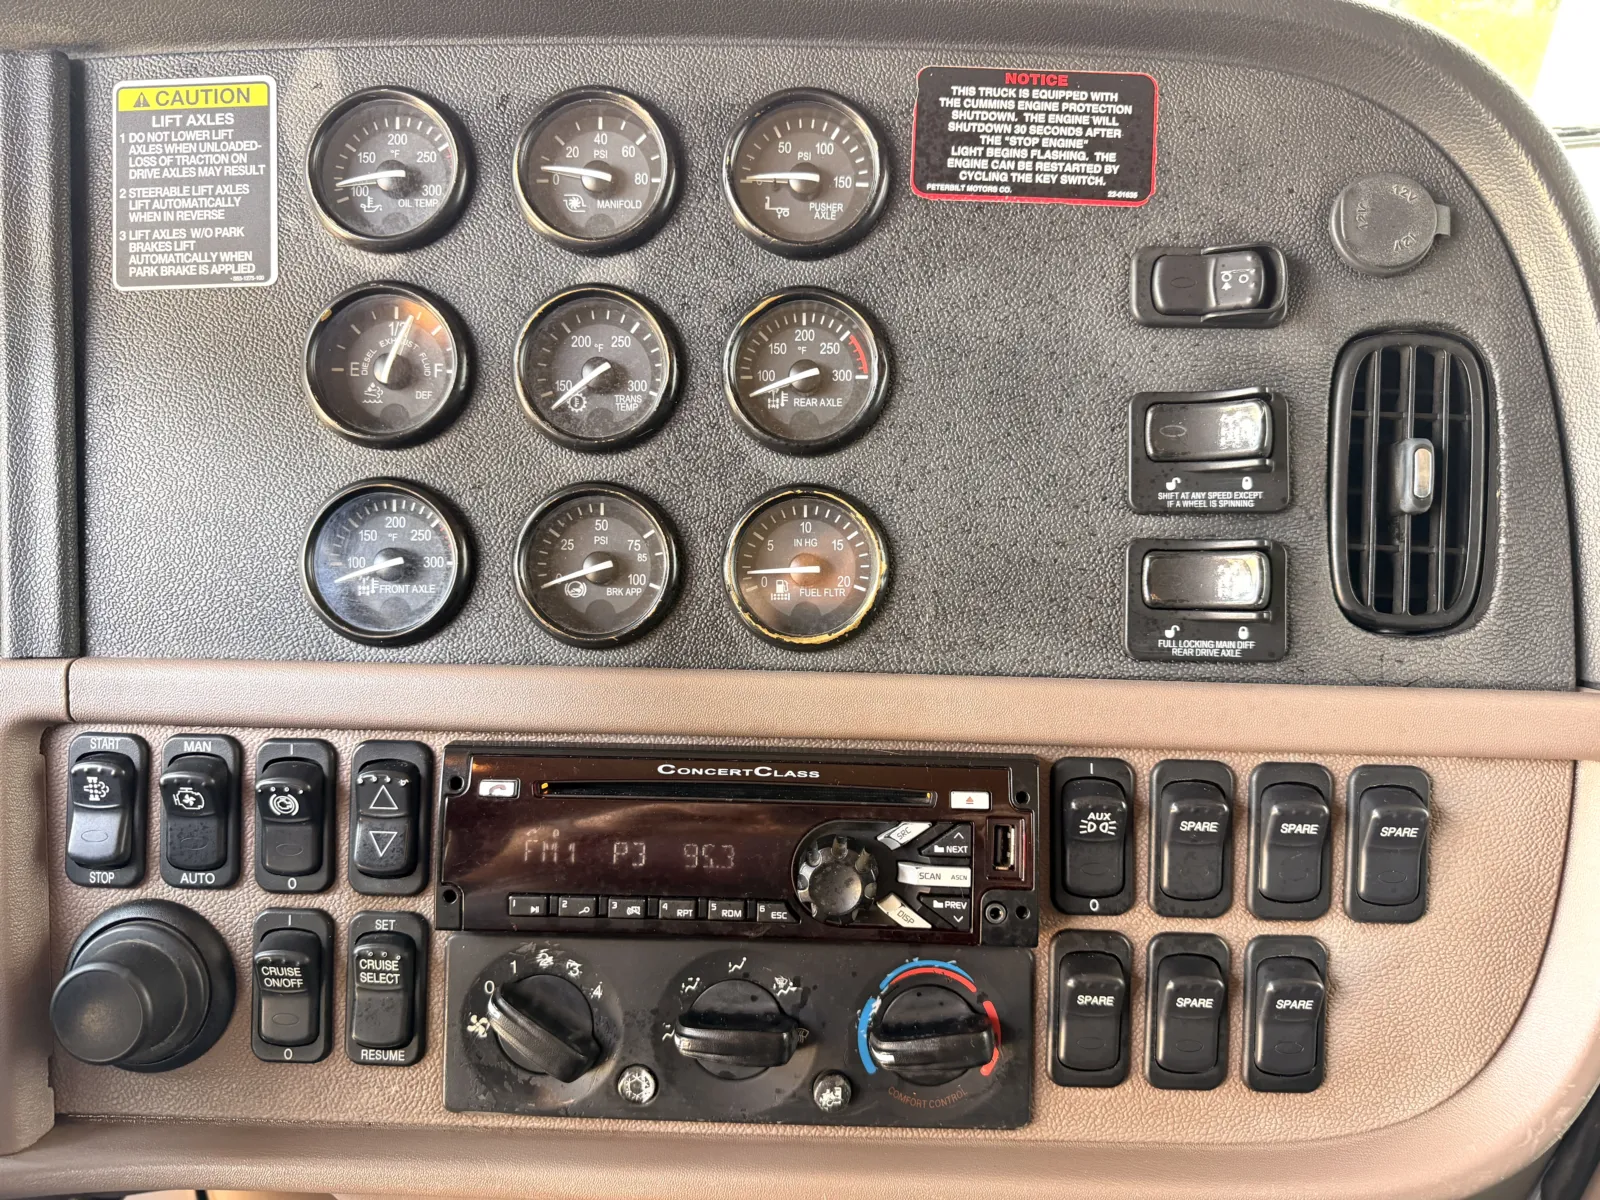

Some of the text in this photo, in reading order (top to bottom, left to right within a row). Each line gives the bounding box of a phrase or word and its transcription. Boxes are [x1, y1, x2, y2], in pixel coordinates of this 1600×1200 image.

[1005, 73, 1068, 87] NOTICE
[156, 88, 250, 106] CAUTION
[951, 86, 1118, 101] THIS TRUCK IS EQUIPPED WITH
[939, 98, 1132, 114] THE CUMMINS ENGINE PROTECTION
[152, 113, 235, 128] LIFT AXLES
[952, 111, 1119, 126] SHUTDOWN. THE ENGINE WILL
[129, 129, 234, 143] DO NOT LOWER LIFT
[388, 134, 407, 145] 200
[594, 134, 607, 144] 40
[129, 144, 163, 155] AXLES
[164, 143, 198, 153] WHEN
[566, 147, 579, 157] 20
[622, 146, 635, 157] 60
[778, 142, 791, 153] 50
[815, 143, 834, 155] 100
[358, 152, 376, 163] 150
[417, 152, 436, 163] 250
[594, 150, 607, 158] PSI
[798, 152, 811, 160] PSI
[129, 165, 265, 179] DRIVE AXLES MAY RESULT
[553, 174, 559, 185] 0
[635, 173, 648, 184] 80
[834, 177, 851, 188] 150
[959, 171, 1106, 187] CYCLING THE KEY SWITCH.
[351, 186, 369, 196] 100
[422, 185, 442, 196] 300
[927, 183, 966, 192] PETERBILT
[967, 185, 997, 193] MOTORS
[416, 200, 438, 208] TEMP
[597, 200, 642, 209] MANIFOLD
[809, 203, 843, 212] PUSHER
[814, 212, 836, 220] AXLE
[129, 251, 252, 265] AUTOMATICALLY WHEN
[129, 263, 255, 277] PARK BRAKE IS APPLIED
[572, 336, 591, 347] 200
[611, 336, 631, 347] 250
[361, 349, 431, 377] DIESEL FLUID
[350, 362, 359, 377] E
[434, 363, 443, 377] F
[555, 380, 573, 391] 150
[628, 380, 647, 391] 300
[415, 391, 432, 399] DEF
[615, 395, 642, 403] TRANS
[794, 398, 842, 407] REAR AXLE
[1158, 492, 1179, 500] SHIFT
[595, 520, 608, 531] 50
[800, 522, 812, 533] 10
[561, 539, 574, 550] 25
[594, 536, 608, 544] PSI
[627, 540, 640, 551] 75
[767, 540, 774, 551] 5
[794, 539, 817, 547] IN HG
[832, 540, 844, 550] 15
[637, 554, 647, 562] 85
[628, 574, 646, 585] 100
[761, 577, 768, 587] 0
[838, 576, 850, 587] 20
[380, 585, 435, 593] FRONT AXLE
[607, 588, 642, 596] BRK APP
[800, 588, 845, 597] FUEL FLTR
[1158, 640, 1177, 648] FULL
[1179, 640, 1214, 648] LOCKING
[1172, 648, 1194, 656] REAR
[90, 738, 120, 749] START
[184, 741, 211, 751] MAN
[1088, 812, 1112, 820] AUX
[1179, 821, 1219, 832] SPARE
[1280, 823, 1319, 835] SPARE
[896, 827, 911, 840] SRC
[1380, 827, 1419, 838] SPARE
[90, 872, 114, 883] STOP
[180, 873, 215, 884] AUTO
[919, 872, 941, 880] SCAN
[562, 900, 567, 908] 2
[612, 901, 618, 909] 3
[945, 901, 967, 910] PREV
[676, 909, 693, 917] RPT
[711, 903, 741, 918] 5 RDM
[771, 912, 787, 920] ESC
[896, 910, 915, 925] DISP
[375, 920, 396, 930] SET
[359, 959, 399, 970] CRUISE
[510, 960, 517, 974] 1
[262, 967, 302, 976] CRUISE
[264, 978, 303, 988] ON/OFF
[360, 974, 400, 984] SELECT
[484, 981, 494, 994] 0
[1076, 995, 1114, 1006] SPARE
[1176, 998, 1214, 1008] SPARE
[1275, 999, 1314, 1010] SPARE
[361, 1050, 405, 1061] RESUME
[888, 1087, 968, 1109] COMFORT CONTROL
